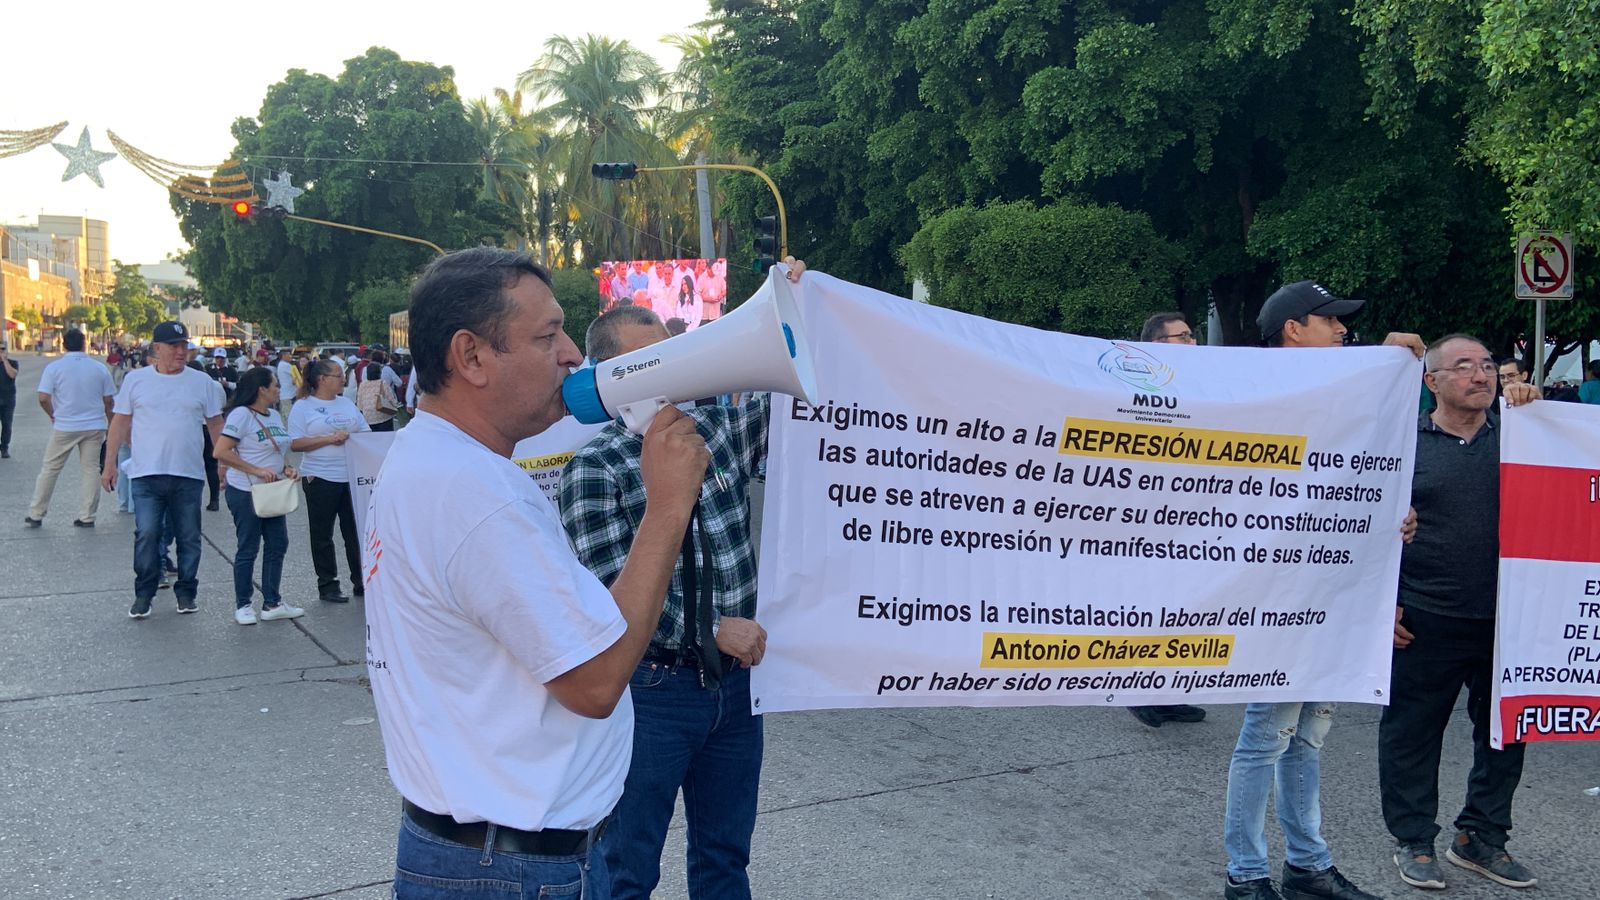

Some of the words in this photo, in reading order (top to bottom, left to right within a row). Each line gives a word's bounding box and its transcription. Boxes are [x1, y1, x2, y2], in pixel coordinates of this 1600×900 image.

[626, 358, 660, 374] Steren
[1133, 393, 1177, 409] MDU
[1117, 408, 1153, 416] Movimiento
[1154, 410, 1190, 419] Democrática
[1135, 415, 1172, 424] Universitario
[791, 397, 908, 430] Exigimos
[916, 416, 948, 435] un
[956, 418, 1005, 442] alto
[1012, 427, 1027, 445] a
[1035, 425, 1057, 448] la
[1064, 427, 1202, 460] REPRESIÓN
[1206, 439, 1302, 466] LABORAL
[1308, 451, 1344, 472] que
[1350, 450, 1402, 475] ejercen
[530, 455, 574, 469] LABORA
[818, 438, 857, 464] las
[866, 445, 1008, 478] autoridades
[1015, 459, 1045, 481] de
[1053, 462, 1075, 484] la
[1083, 465, 1133, 489] UAS
[1138, 474, 1164, 491] en
[1171, 474, 1233, 494] contra
[1238, 475, 1263, 496] de
[1269, 476, 1299, 499] los
[1307, 483, 1383, 502] maestros
[828, 482, 877, 507] que
[885, 487, 913, 506] se
[920, 486, 1004, 513] atreven
[1012, 499, 1026, 515] a
[1034, 497, 1117, 523] ejercer
[1121, 507, 1148, 524] su
[1153, 505, 1238, 528] derecho
[1244, 512, 1372, 534] constitucional
[842, 518, 872, 542] de
[881, 520, 933, 546] libre
[940, 529, 1052, 553] expresión
[1059, 537, 1073, 559] y
[1079, 535, 1236, 562] manifestación
[1243, 543, 1267, 564] de
[1272, 548, 1302, 564] sus
[1306, 545, 1354, 565] ideas.
[858, 595, 971, 626] Exigimos
[980, 600, 999, 623] la
[1008, 602, 1153, 628] reinstalación
[1160, 606, 1223, 628] laboral
[1227, 606, 1255, 626] del
[1261, 608, 1326, 627] maestro
[1563, 624, 1588, 639] DE
[990, 637, 1081, 660] Antonio
[1088, 639, 1161, 660] Chávez
[1165, 638, 1230, 659] Sevilla
[877, 674, 924, 695] por
[928, 672, 999, 691] haber
[1002, 672, 1052, 691] sido
[1056, 671, 1166, 690] rescindido
[1171, 669, 1290, 693] injustamente.
